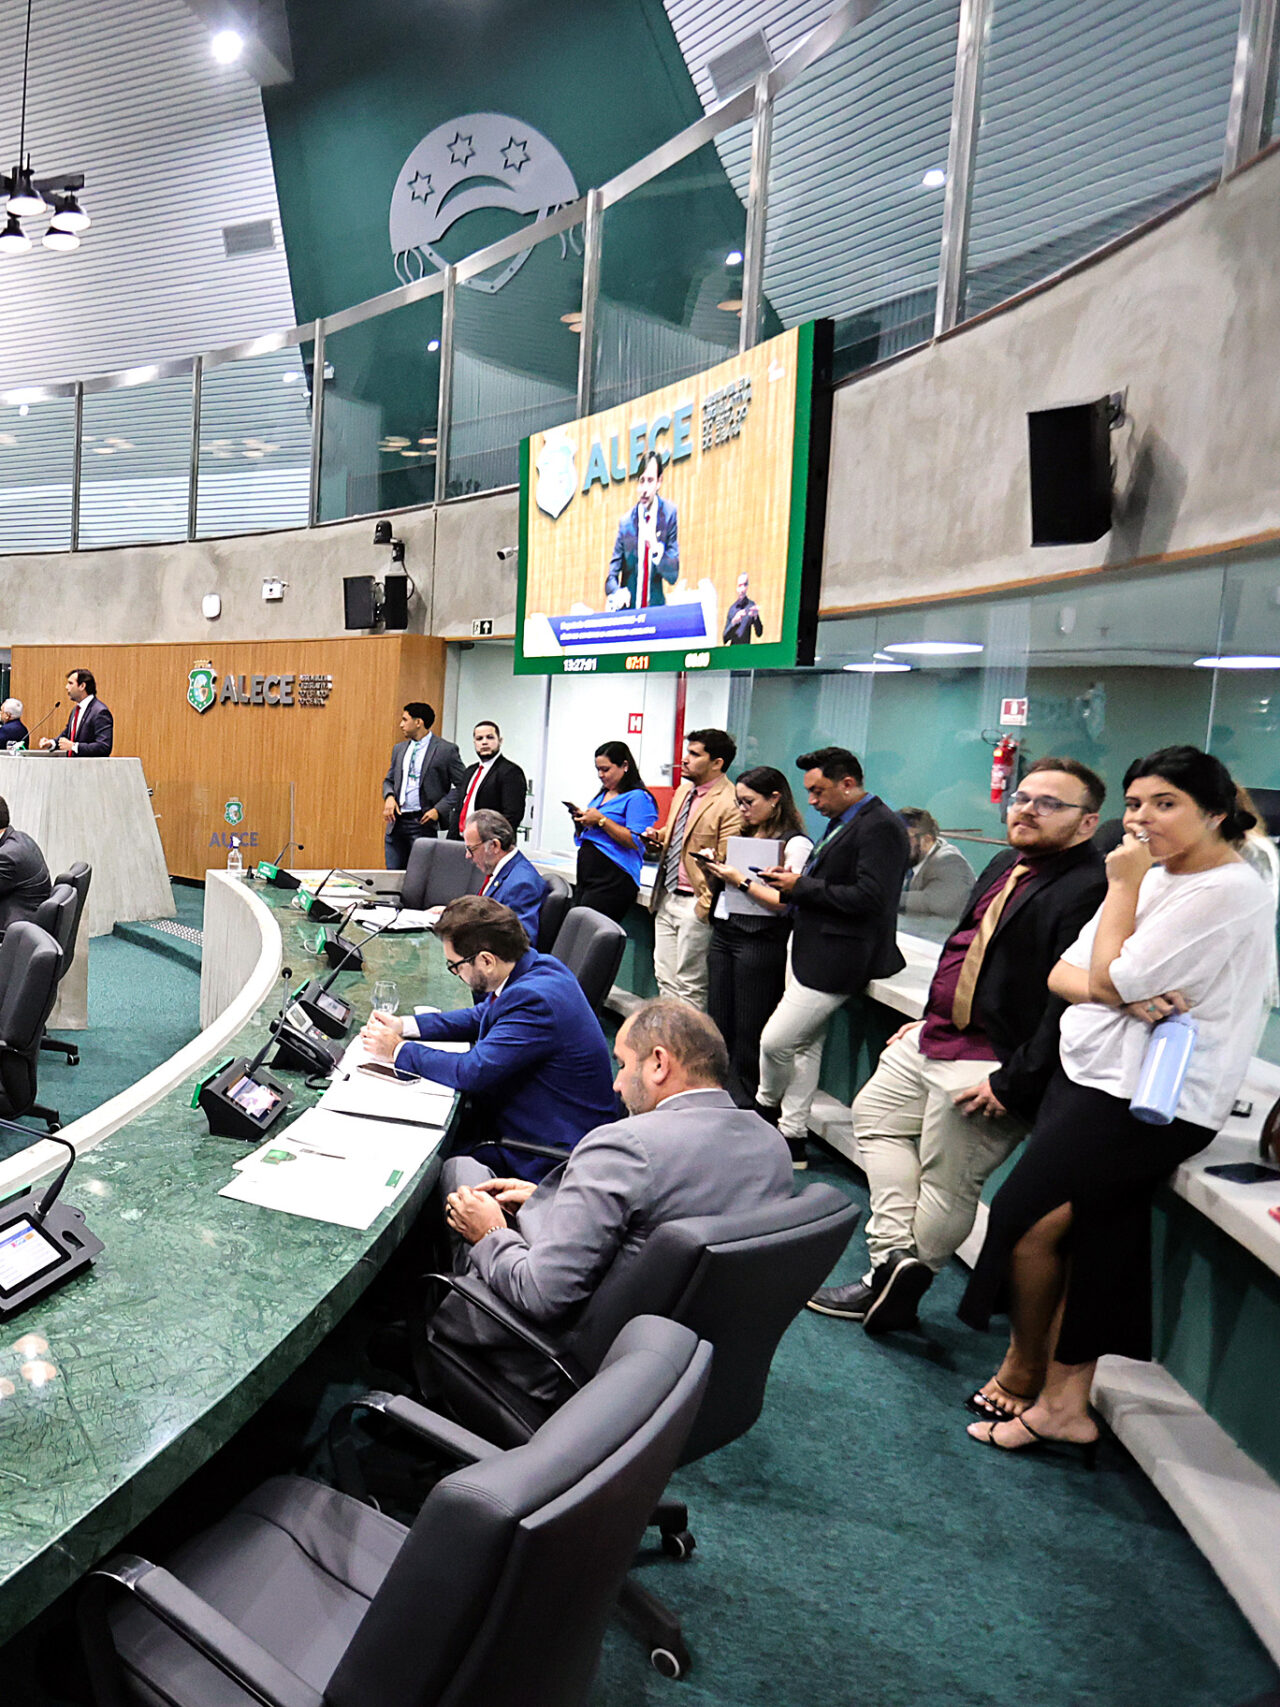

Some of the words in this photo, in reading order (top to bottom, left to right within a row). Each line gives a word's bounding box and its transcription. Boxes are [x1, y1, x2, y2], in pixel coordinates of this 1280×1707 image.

[220, 674, 296, 707] ALECE
[630, 716, 642, 731] H
[209, 832, 259, 848] ALCE
